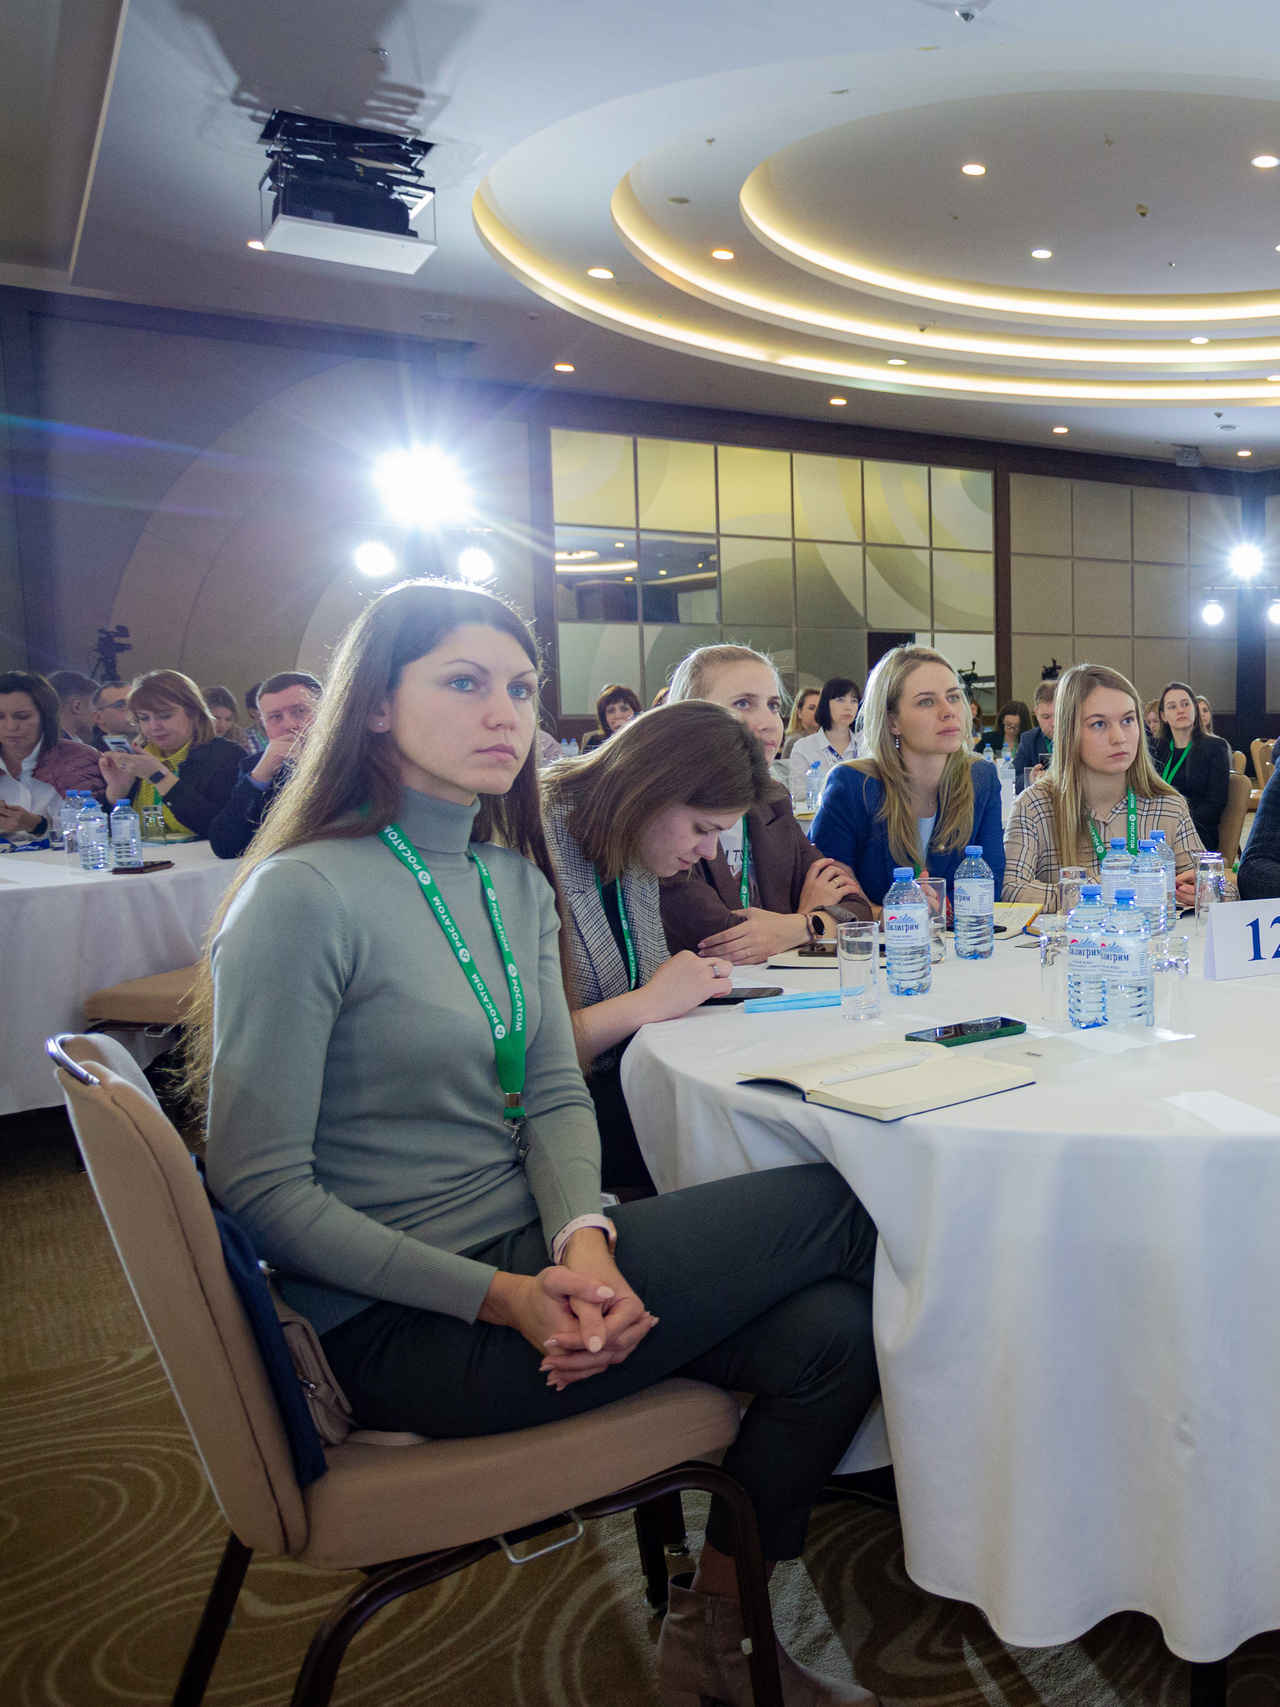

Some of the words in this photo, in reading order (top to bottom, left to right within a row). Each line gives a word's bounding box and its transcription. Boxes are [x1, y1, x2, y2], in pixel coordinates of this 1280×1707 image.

[433, 896, 461, 949] РОСАТОМ
[491, 902, 510, 952] РОСАТОМ
[472, 973, 500, 1025] РОСАТОМ
[511, 978, 524, 1032] РОСАТОМ
